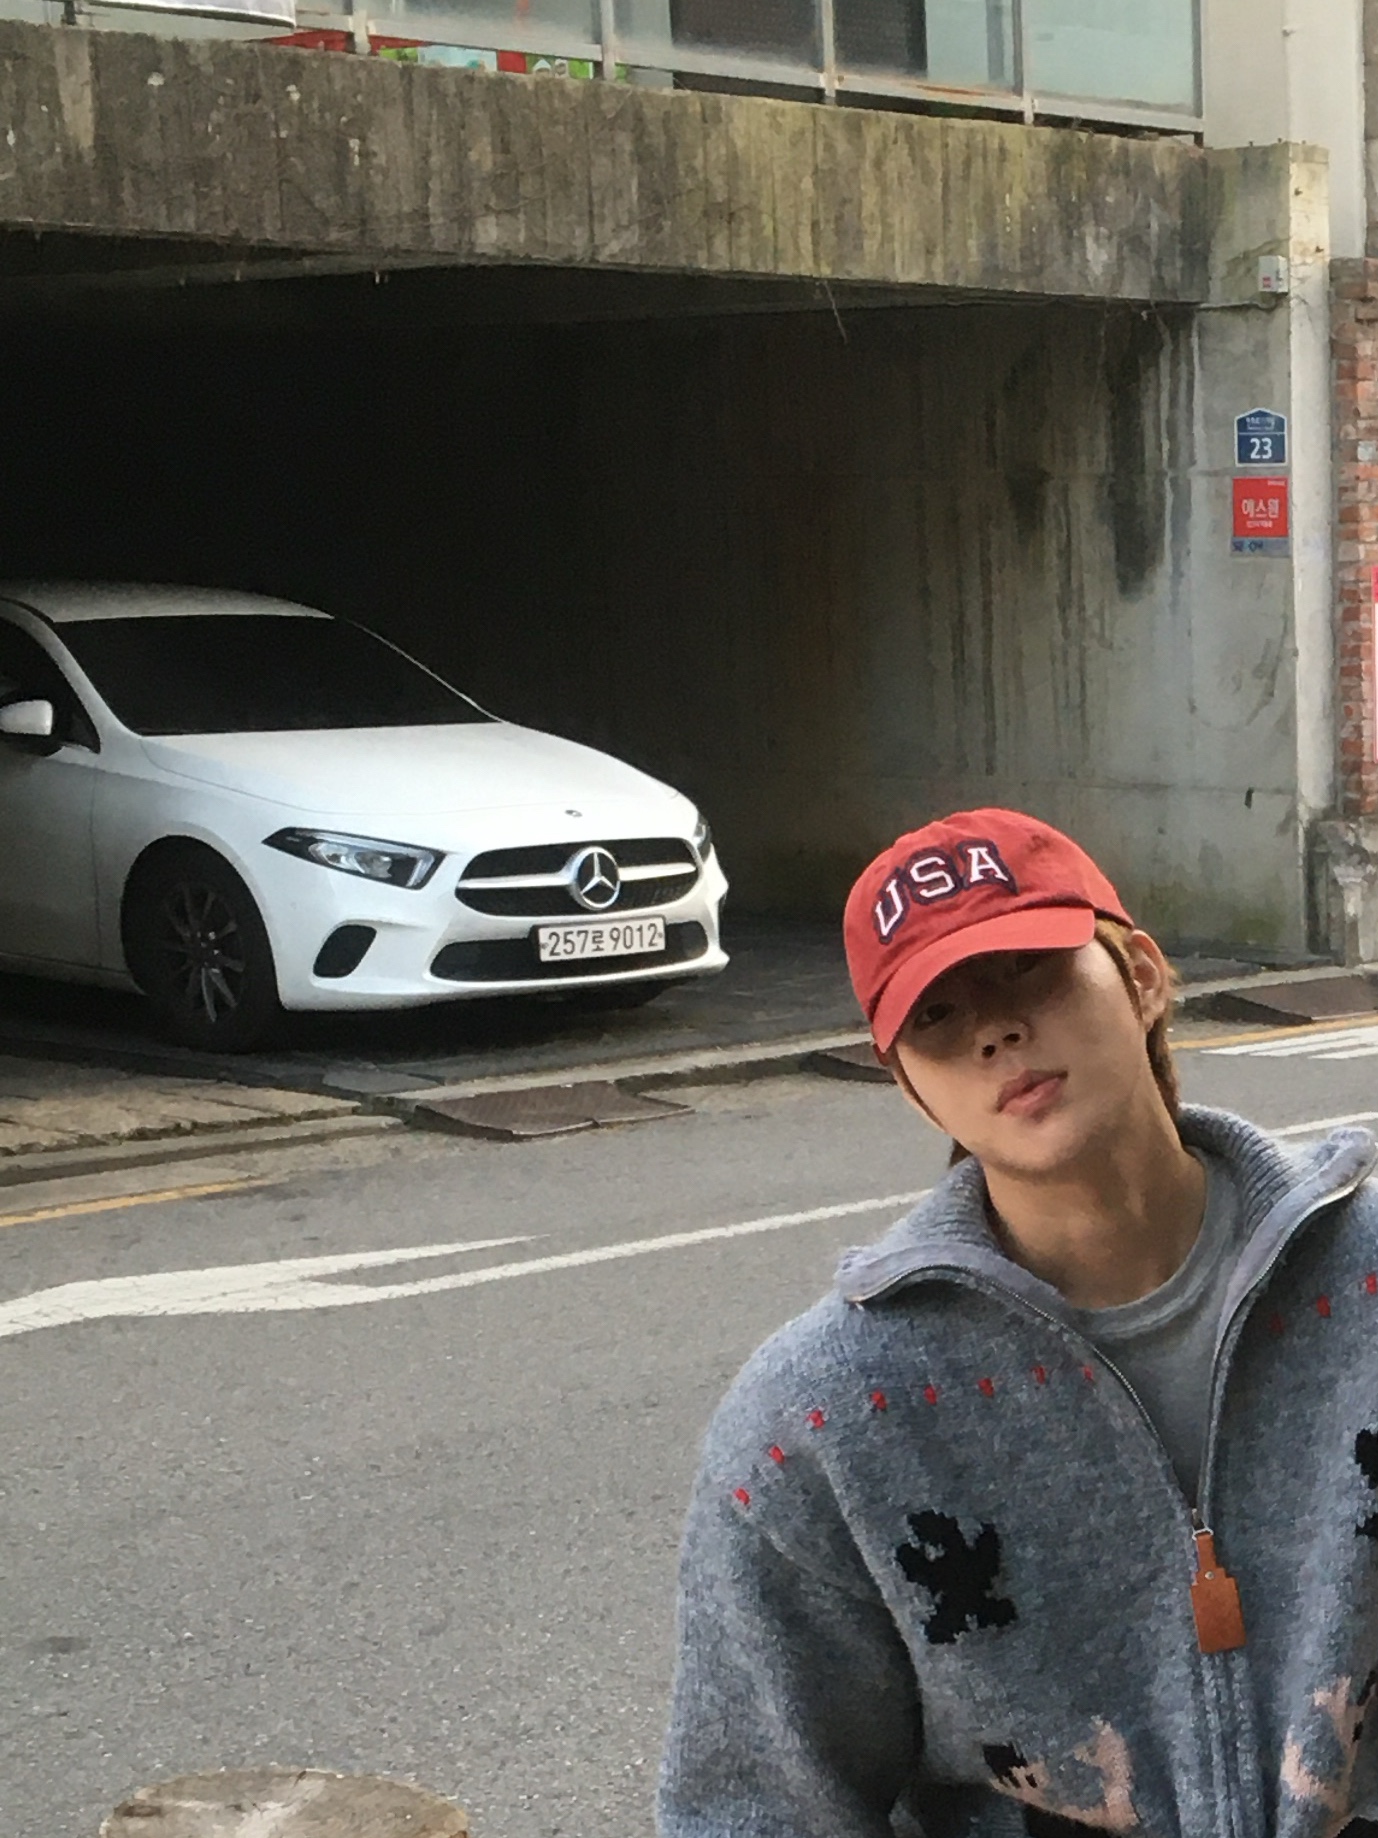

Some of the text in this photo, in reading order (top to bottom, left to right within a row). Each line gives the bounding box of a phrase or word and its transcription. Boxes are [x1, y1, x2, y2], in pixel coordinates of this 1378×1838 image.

[1250, 437, 1272, 459] 23
[1241, 498, 1279, 518] 에스원
[873, 842, 1015, 942] USA
